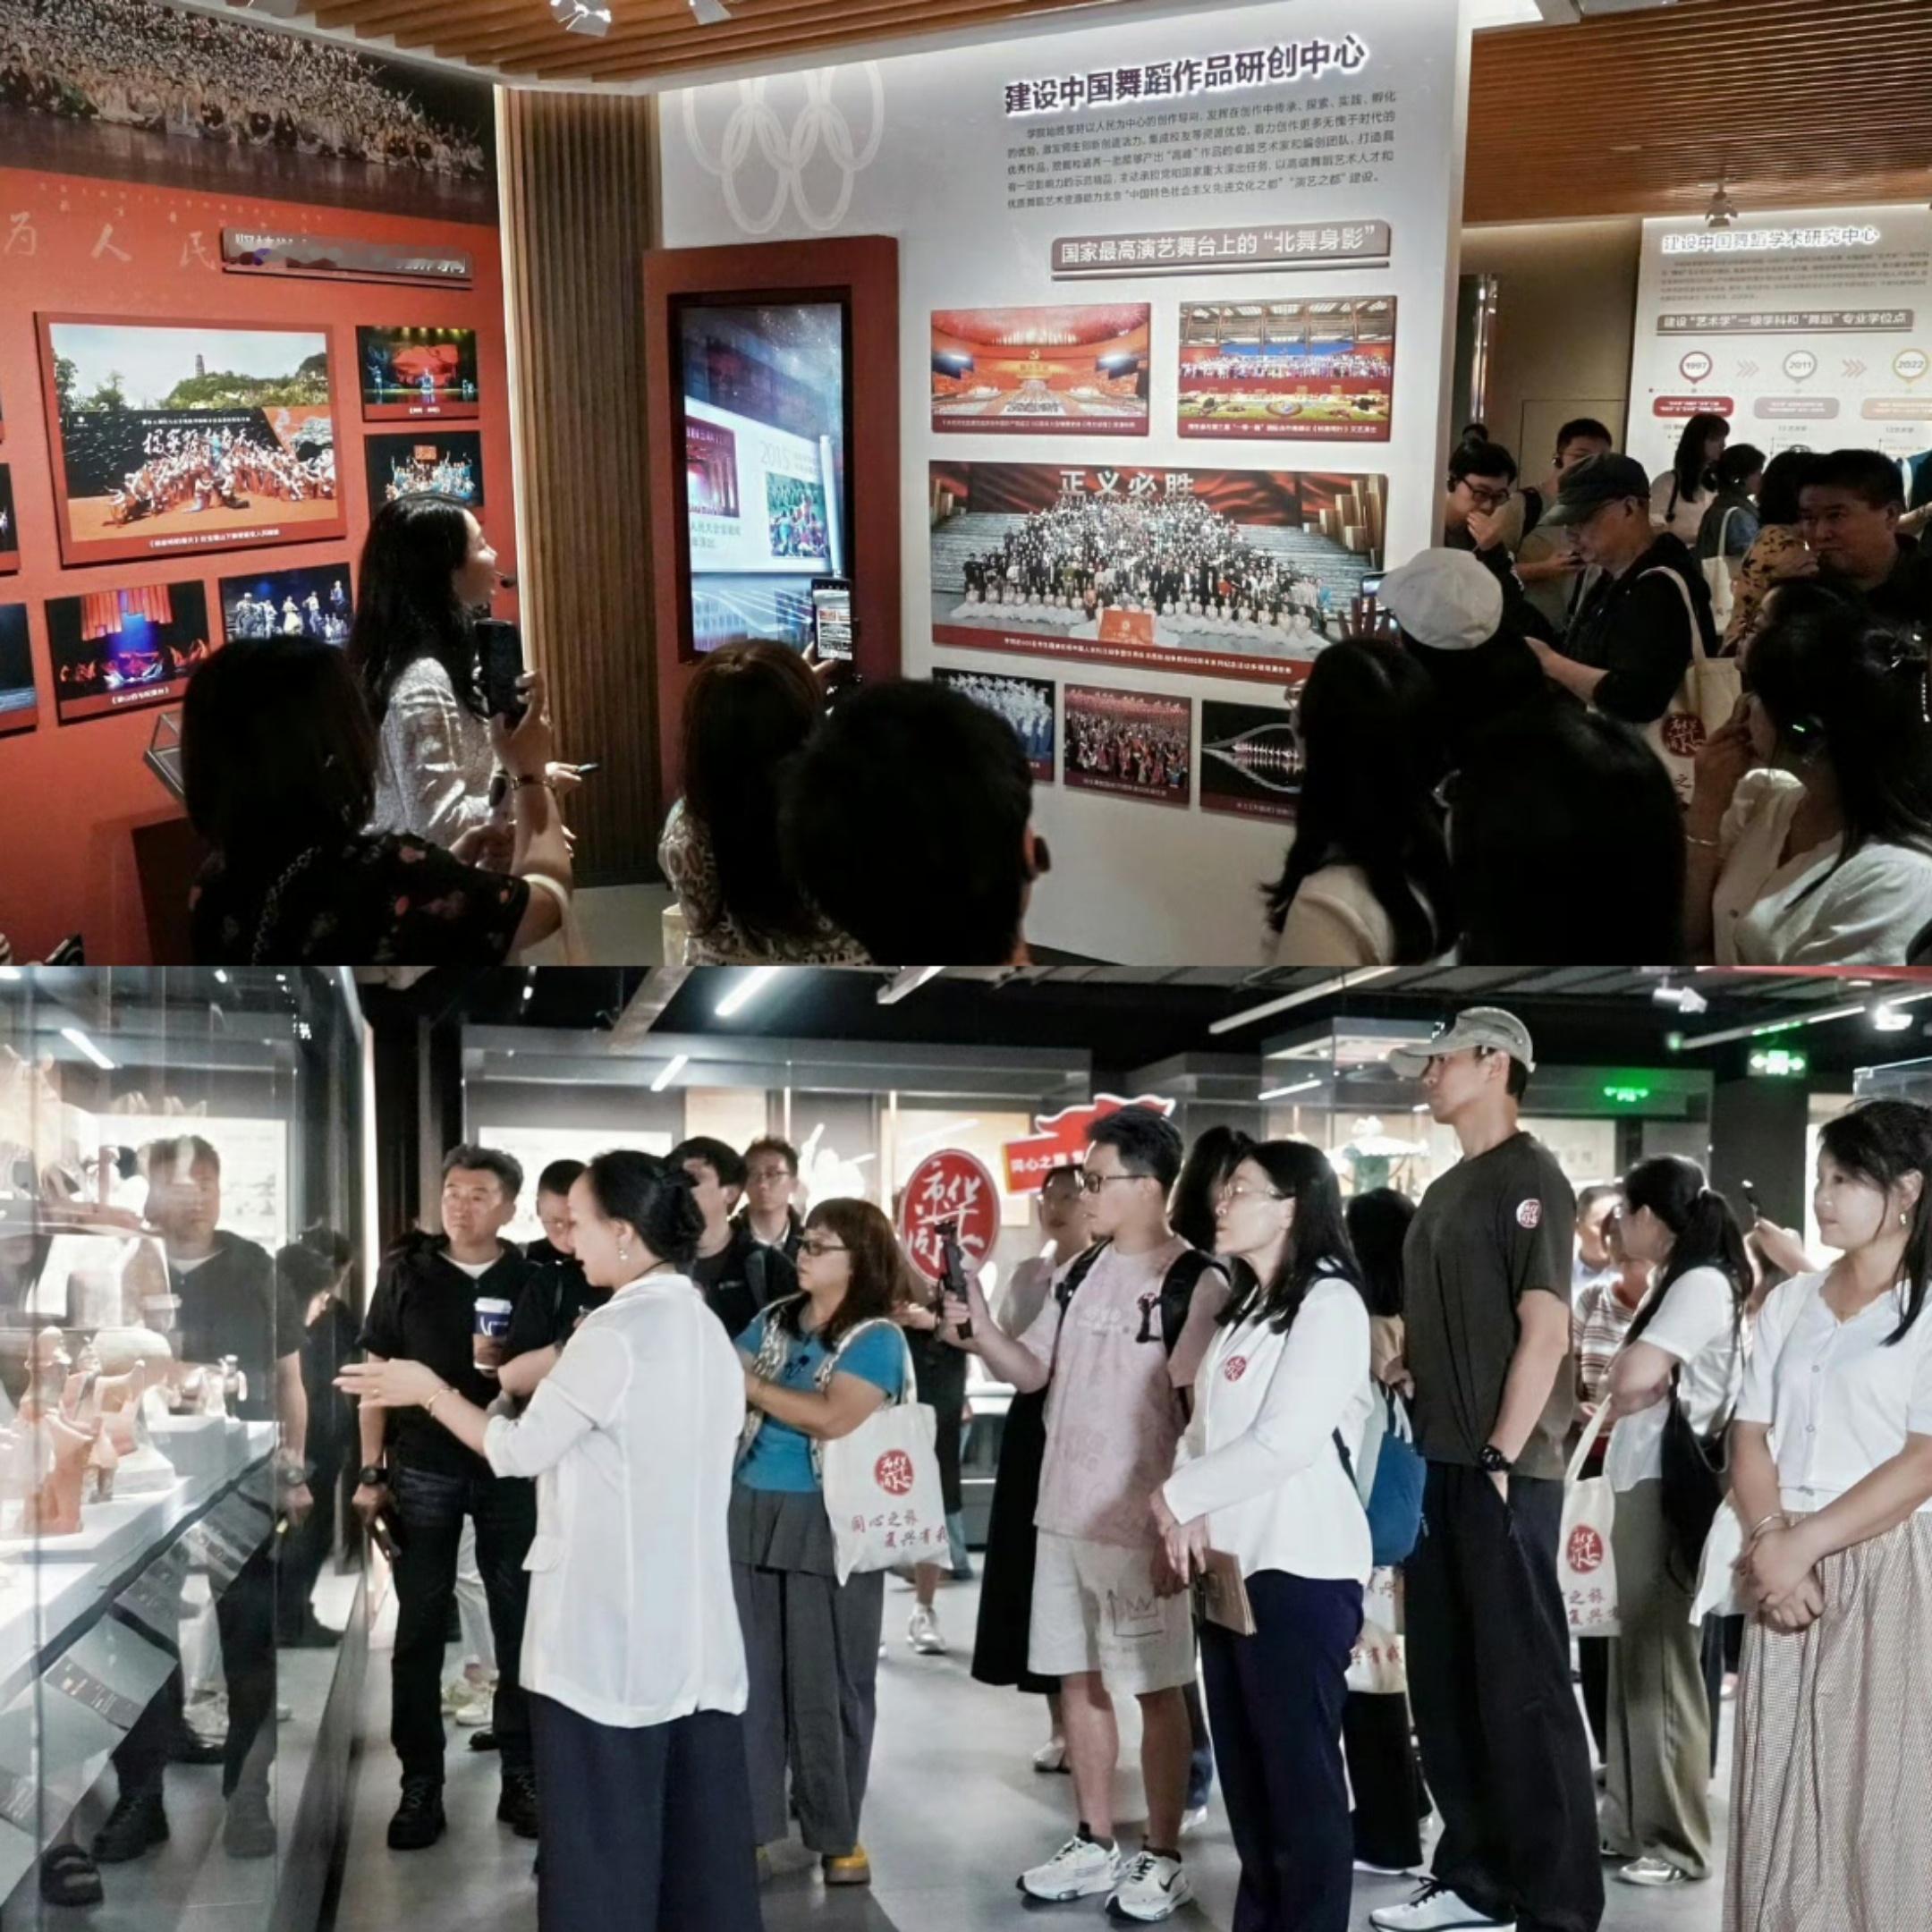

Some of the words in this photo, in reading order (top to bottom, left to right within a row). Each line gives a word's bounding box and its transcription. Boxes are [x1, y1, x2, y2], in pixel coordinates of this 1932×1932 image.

[1004, 36, 1366, 114] 建设中国舞蹈作品研创中心
[1061, 225, 1376, 264] 国家最高演艺舞台上的“北舞身影”
[1663, 228, 1879, 252] 建设中国舞蹈学术研究中心
[1789, 360, 1812, 369] 2011
[1897, 360, 1925, 369] 2022
[1057, 470, 1195, 498] 正义必胜
[851, 1509, 919, 1533] 同心之旅
[1562, 1588, 1606, 1605] 之旅
